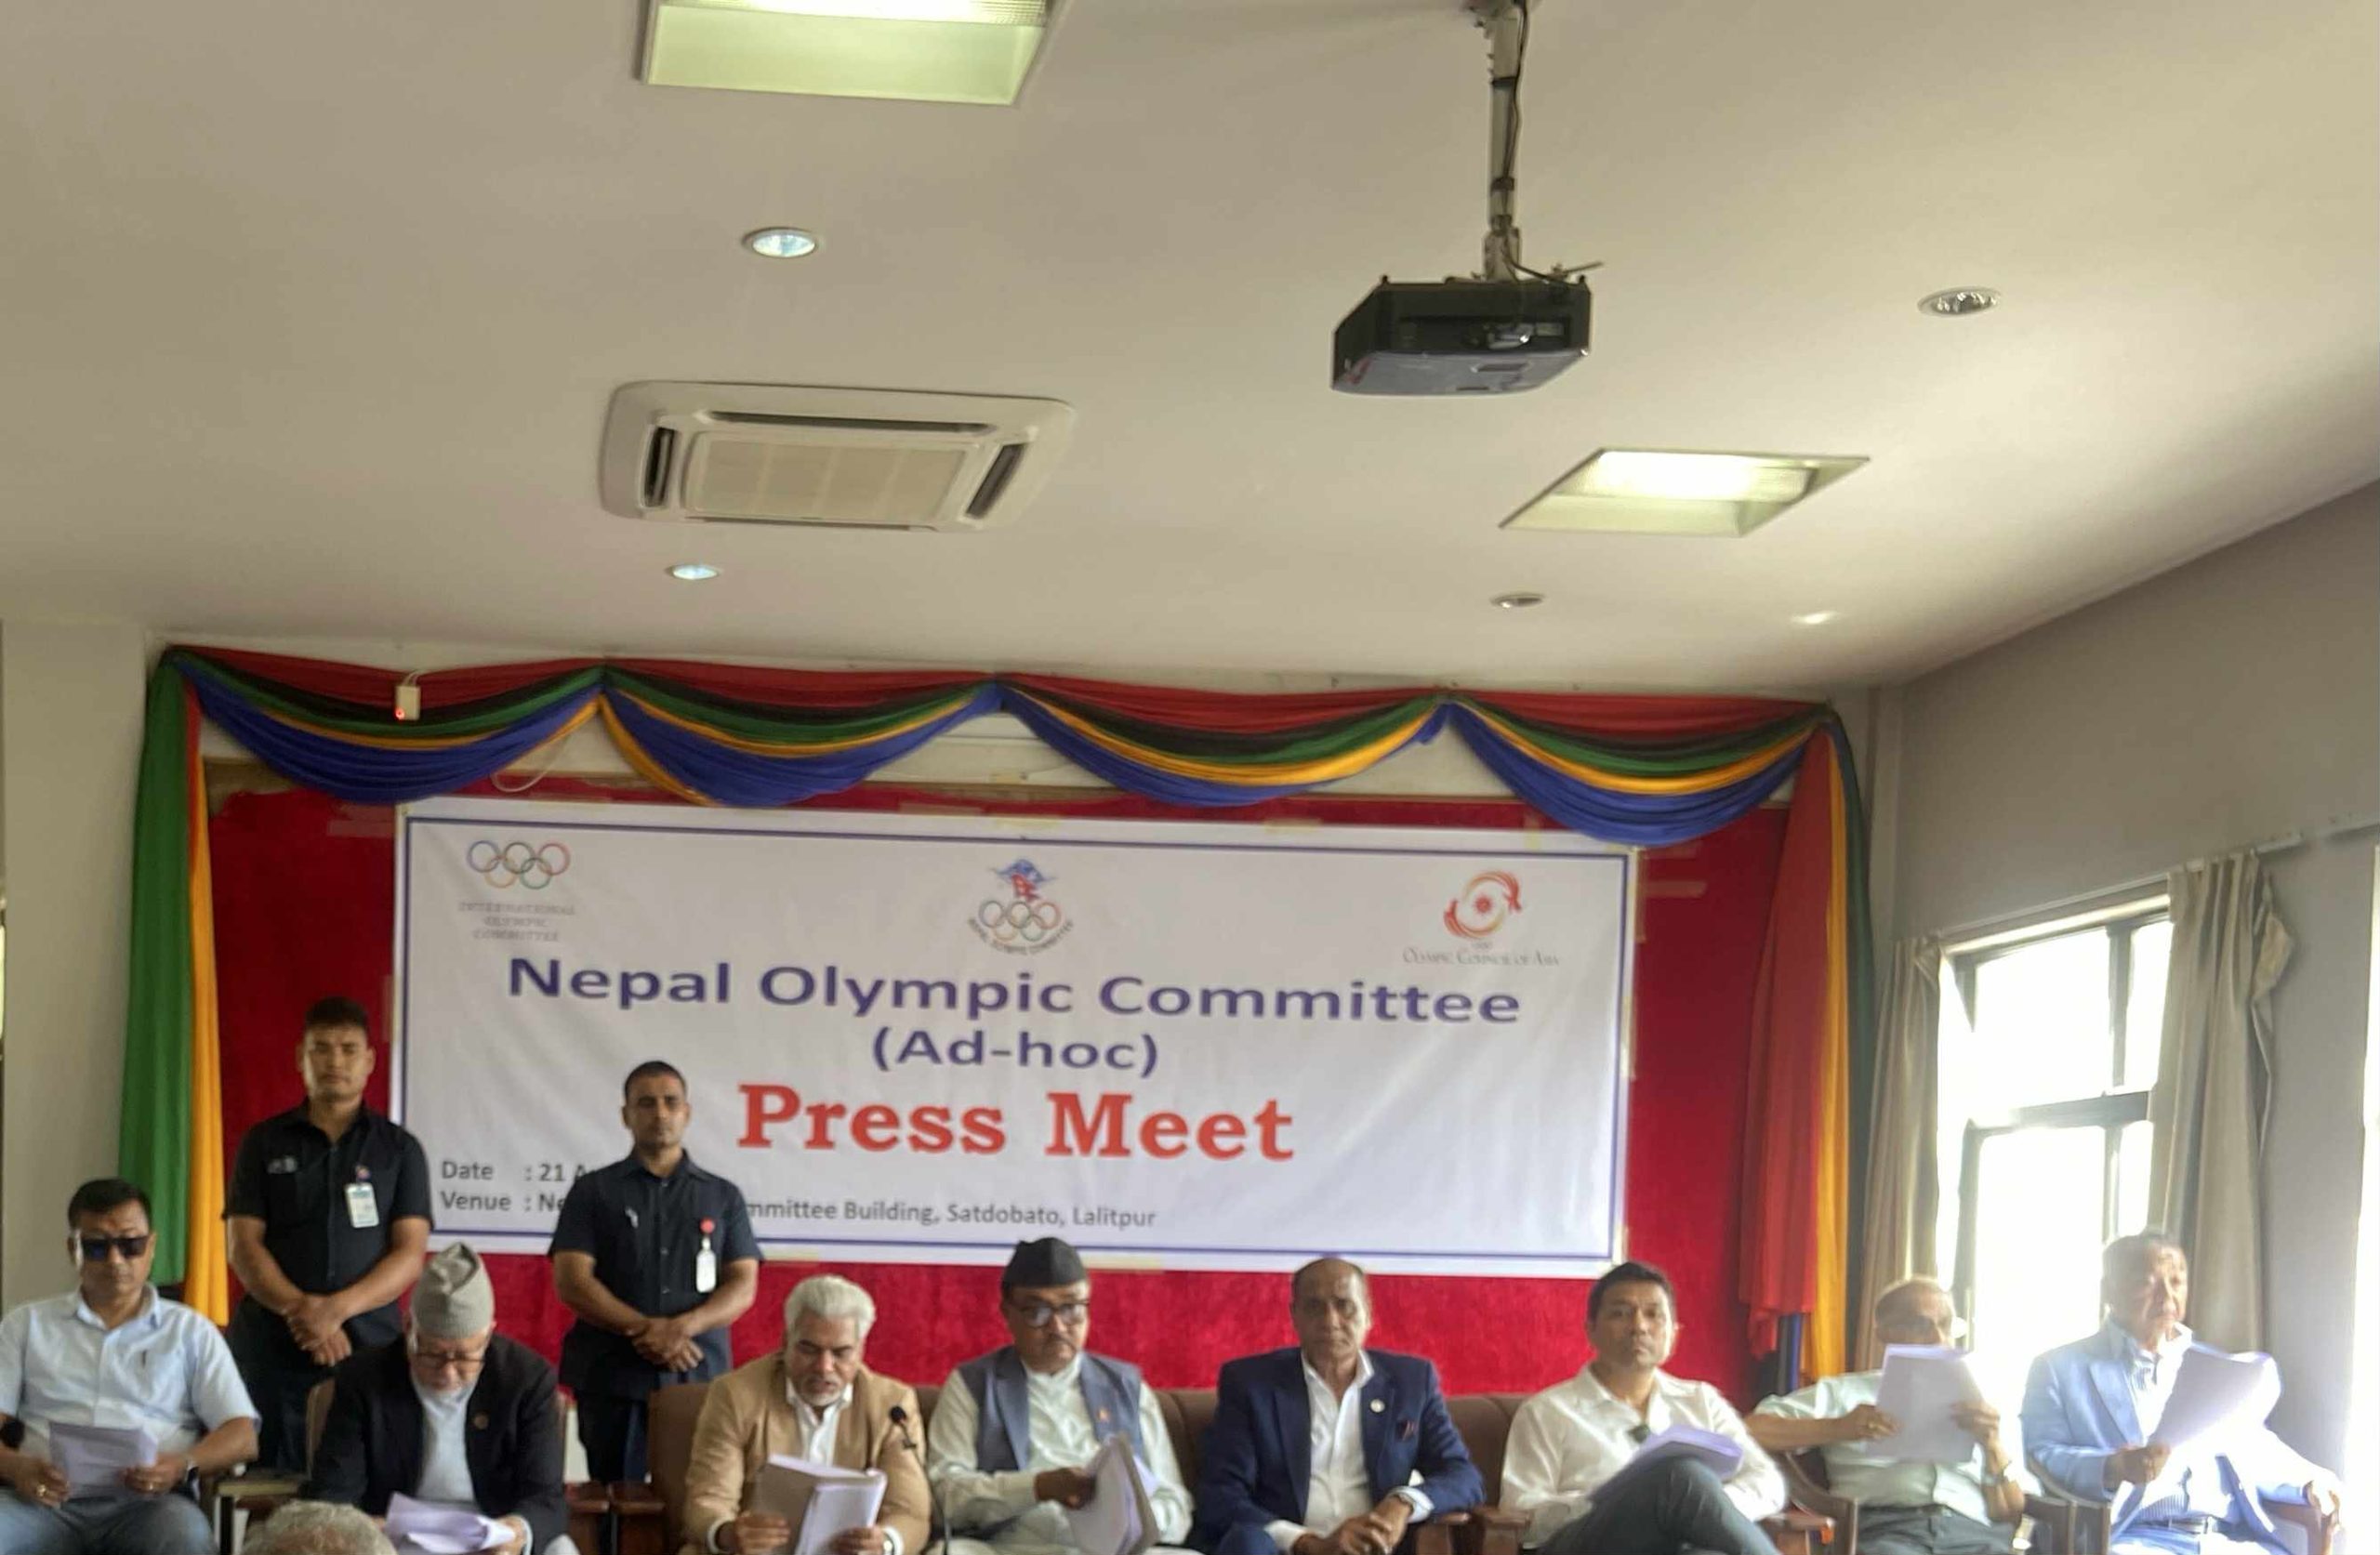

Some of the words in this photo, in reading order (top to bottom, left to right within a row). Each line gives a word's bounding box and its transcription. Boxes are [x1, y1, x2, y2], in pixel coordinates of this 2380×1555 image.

[510, 957, 730, 1010] Nepal
[759, 965, 1073, 1020] Olympic
[1099, 975, 1520, 1023] Committee
[873, 1026, 1158, 1078] (Ad-hoc)
[737, 1083, 1007, 1153] Press
[1045, 1091, 1294, 1162] Meet
[442, 1161, 494, 1180] Date
[538, 1163, 566, 1182] 21
[440, 1191, 510, 1212] Venue
[747, 1198, 836, 1219] mmittee
[844, 1200, 941, 1226] Building,
[946, 1203, 1065, 1228] Satdobato,
[1072, 1205, 1157, 1228] Lalitpur
